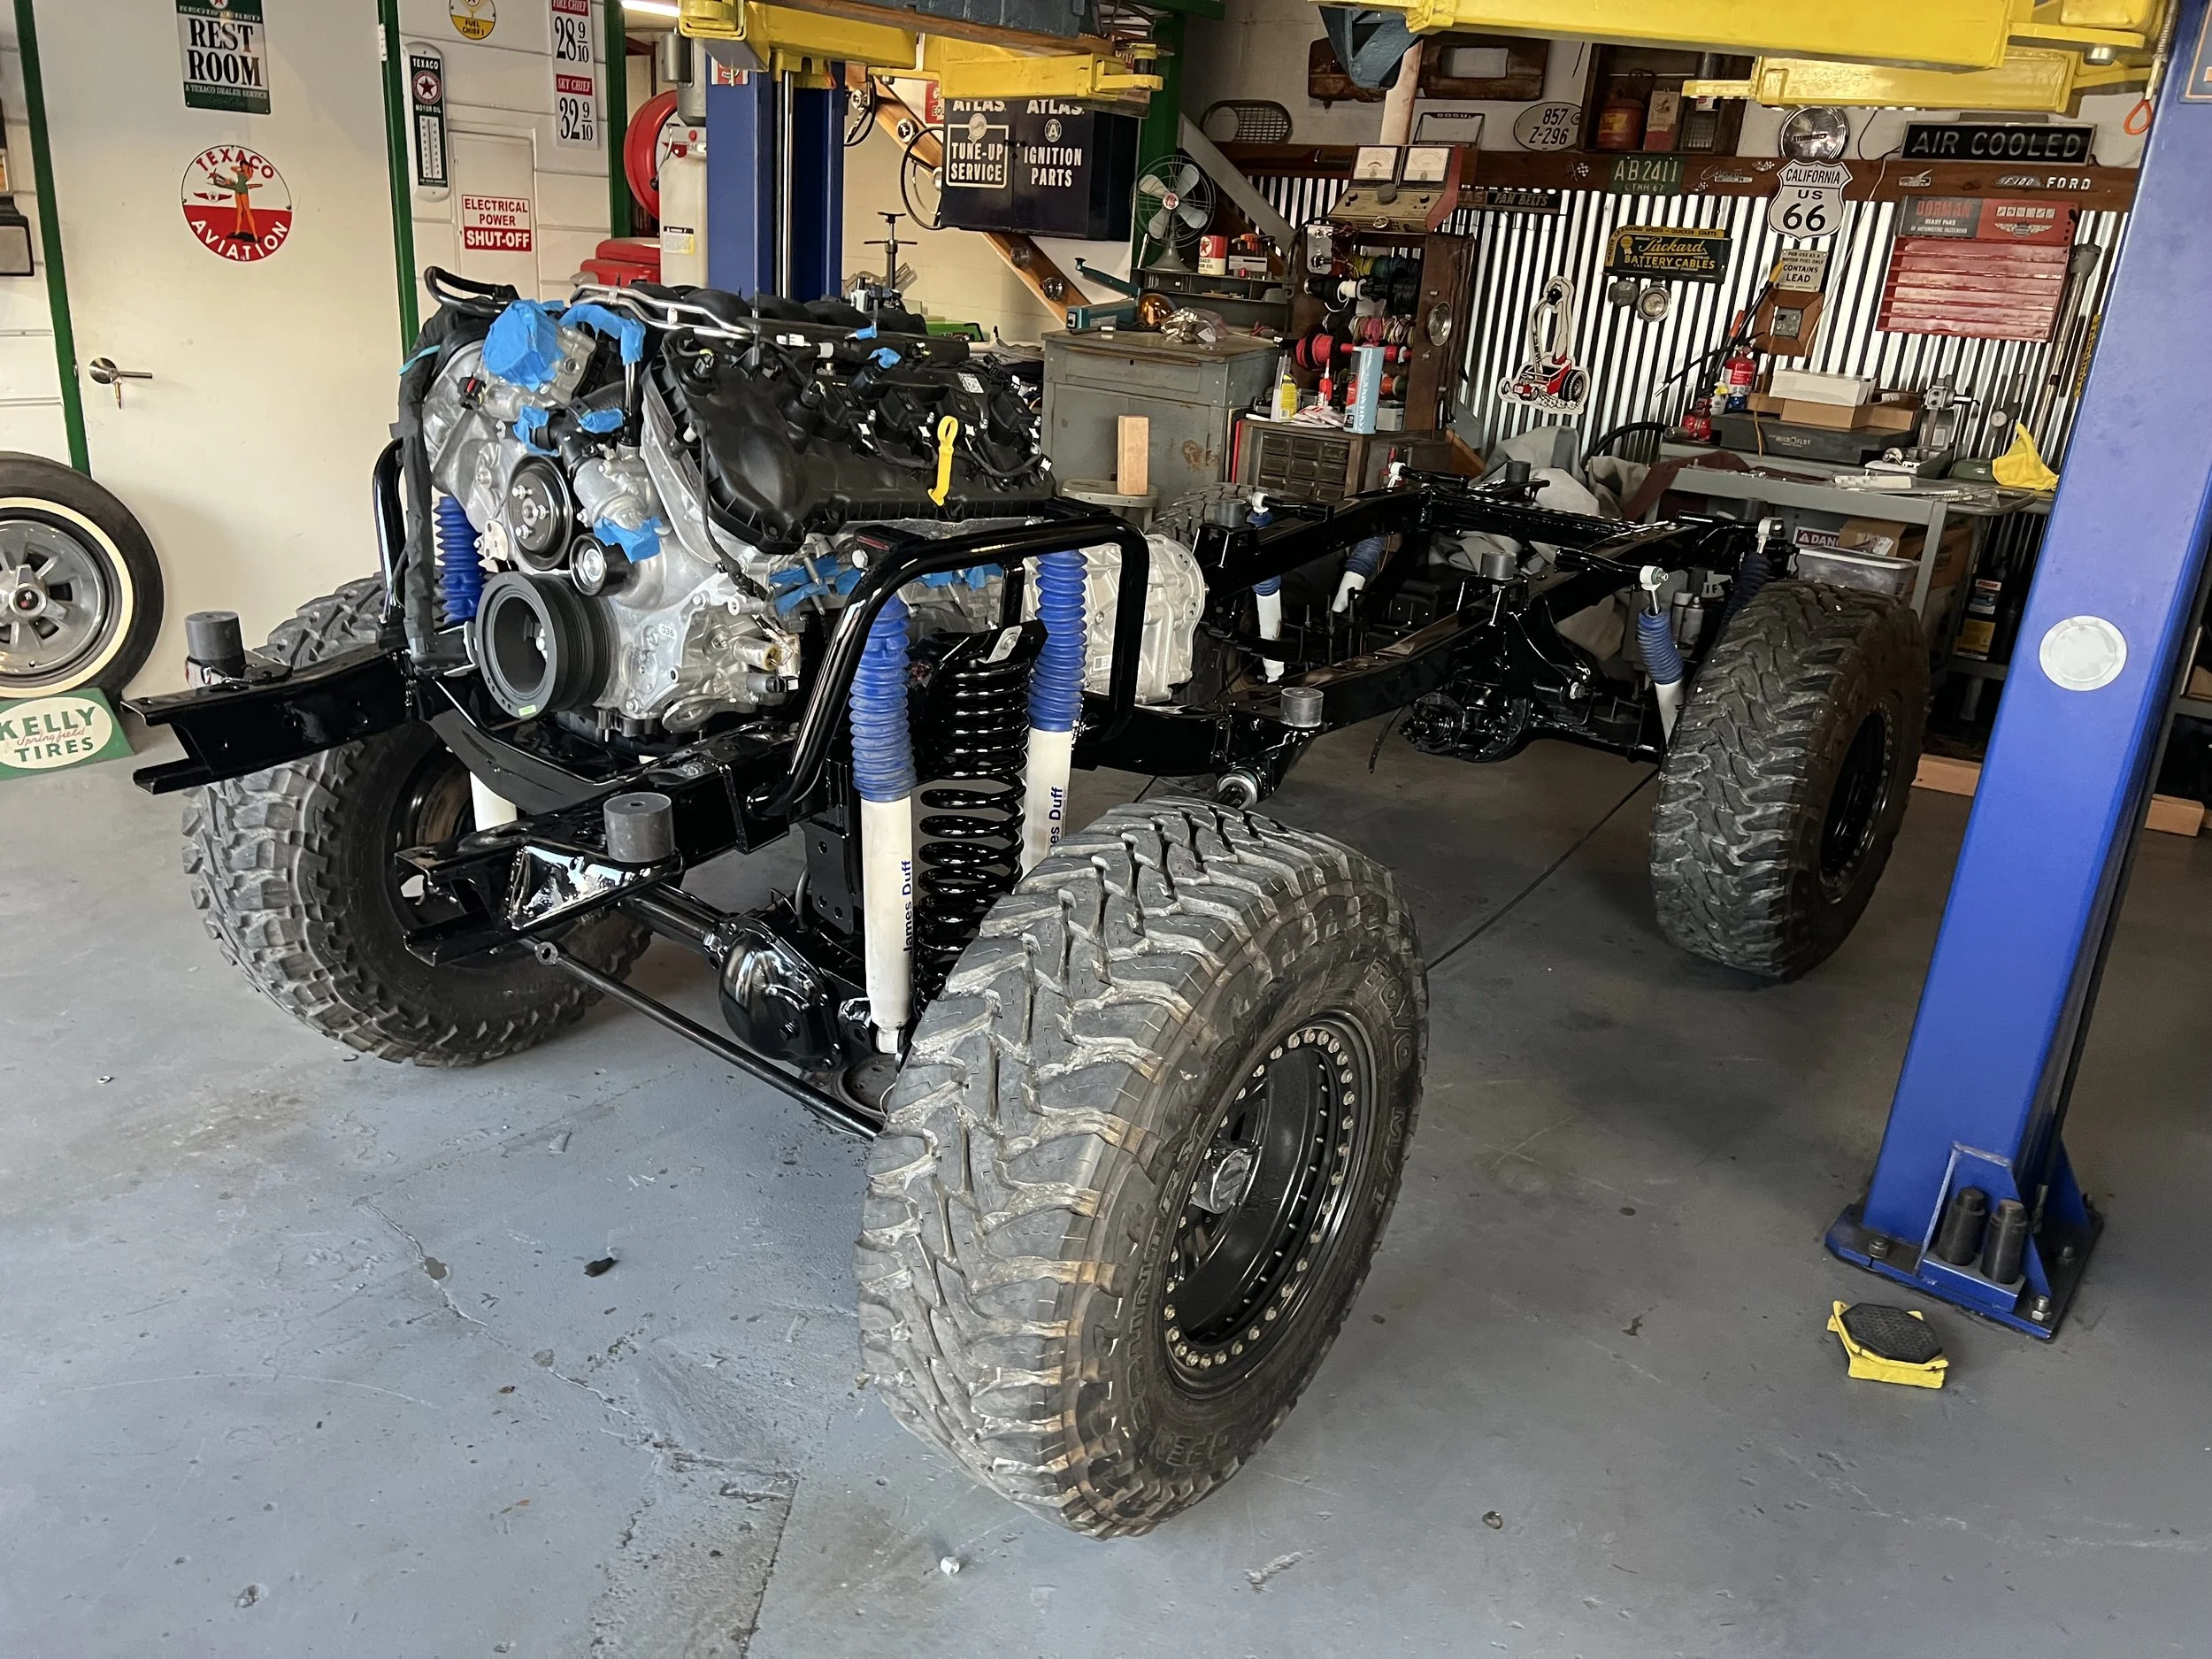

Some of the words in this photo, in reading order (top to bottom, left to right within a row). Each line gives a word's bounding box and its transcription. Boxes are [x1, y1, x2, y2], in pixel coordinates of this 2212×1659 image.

[568, 1, 588, 12] CHIEF
[188, 18, 254, 53] REST
[462, 26, 480, 35] CHIEF
[555, 16, 577, 61] 28
[579, 21, 586, 39] 9
[578, 46, 589, 63] 10
[187, 49, 263, 88] ROOM
[412, 58, 439, 70] TEXACO
[185, 83, 190, 92] A
[190, 84, 217, 94] TEXACO
[217, 87, 242, 96] DEALER
[557, 79, 570, 90] SKY
[571, 80, 591, 92] CHIEF
[582, 101, 590, 119] 9
[953, 100, 1005, 111] ATLAS
[1026, 99, 1083, 115] ATLAS
[560, 97, 580, 140] 32
[1542, 108, 1569, 126] 857
[581, 124, 593, 141] 10
[1529, 127, 1570, 145] Z-296
[951, 142, 1003, 161] TUNE-UP
[1911, 130, 1960, 154] AIR
[1970, 132, 2081, 157] COOLED
[195, 148, 275, 180] TEXACO
[1024, 146, 1082, 166] IGNITION
[950, 163, 1002, 181] SERVICE
[1031, 168, 1072, 188] PARTS
[1786, 168, 1840, 185] CALIFORNIA
[2046, 176, 2092, 190] FORD
[1494, 193, 1516, 204] FAN
[1518, 194, 1549, 206] BELTS
[1797, 189, 1824, 200] US
[465, 198, 527, 212] ELECTRICAL
[1916, 200, 1971, 217] DORMAN
[479, 213, 516, 227] POWER
[1783, 203, 1826, 232] 66
[190, 220, 288, 260] AVIATION
[466, 230, 530, 248] SHUT-OFF
[1639, 236, 1708, 253] Packard
[1624, 254, 1675, 267] BATTERY
[1675, 256, 1716, 270] CABLES
[1783, 265, 1818, 273] CONTAINS
[1786, 273, 1811, 283] LEAD
[0, 706, 96, 741] KELLY
[16, 727, 86, 747] Springfield
[14, 737, 94, 763] TIRES
[1048, 786, 1063, 821] Duff
[901, 860, 912, 896] Duff
[902, 902, 912, 954] James
